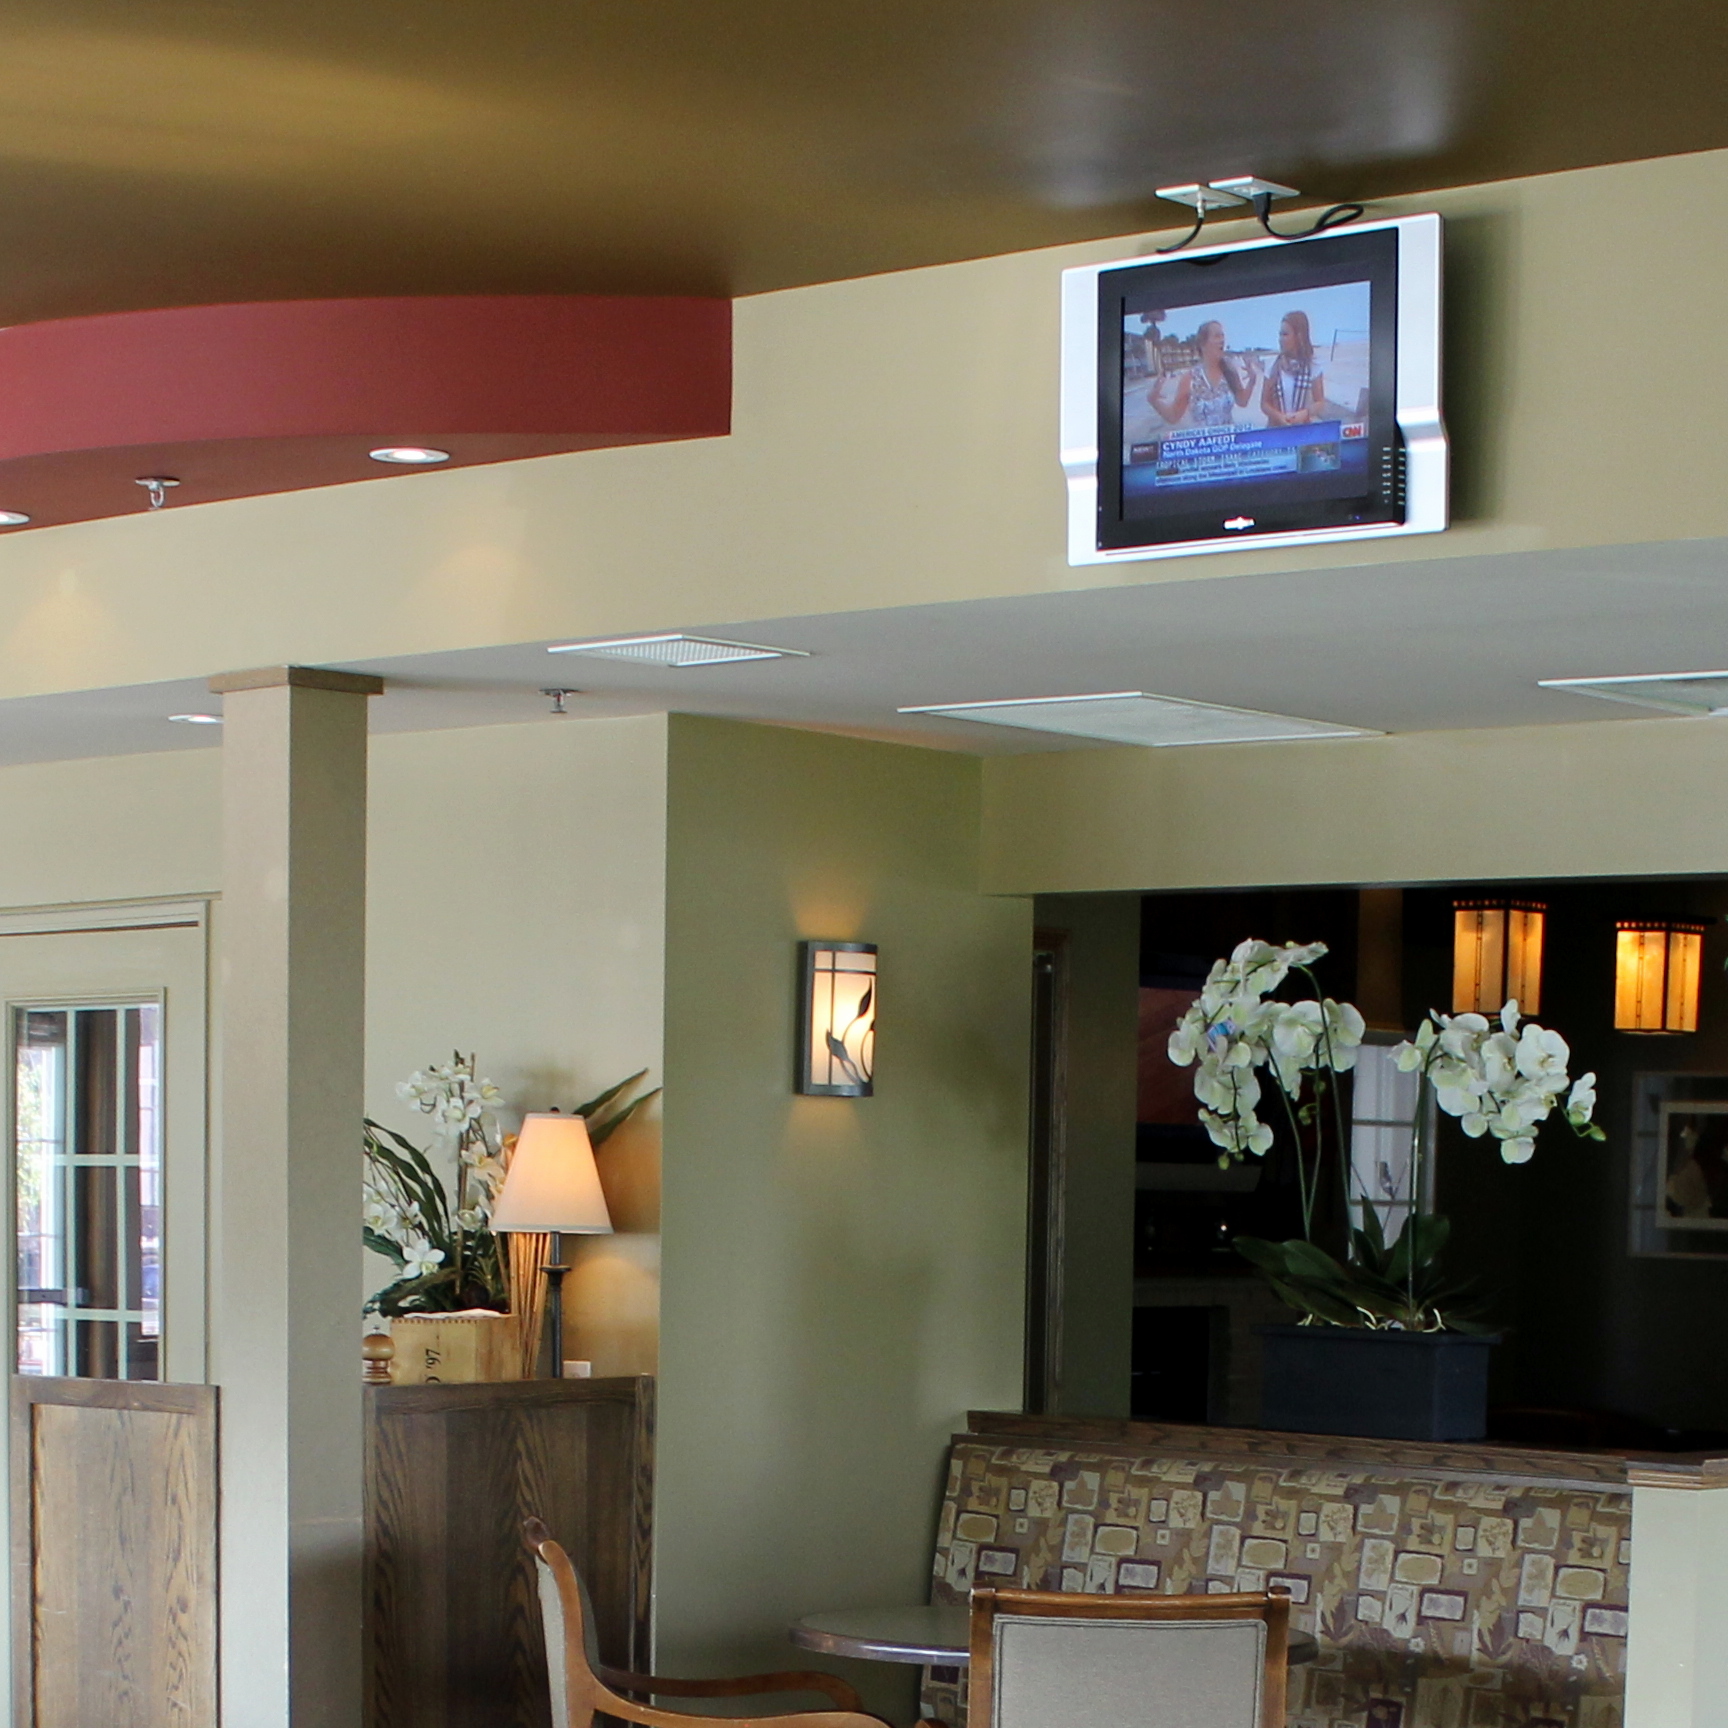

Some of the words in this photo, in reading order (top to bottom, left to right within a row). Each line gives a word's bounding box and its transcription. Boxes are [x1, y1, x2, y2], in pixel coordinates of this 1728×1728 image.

[1342, 425, 1362, 438] CNN
[1162, 439, 1196, 451] CYNDY
[425, 1348, 441, 1369] '97
